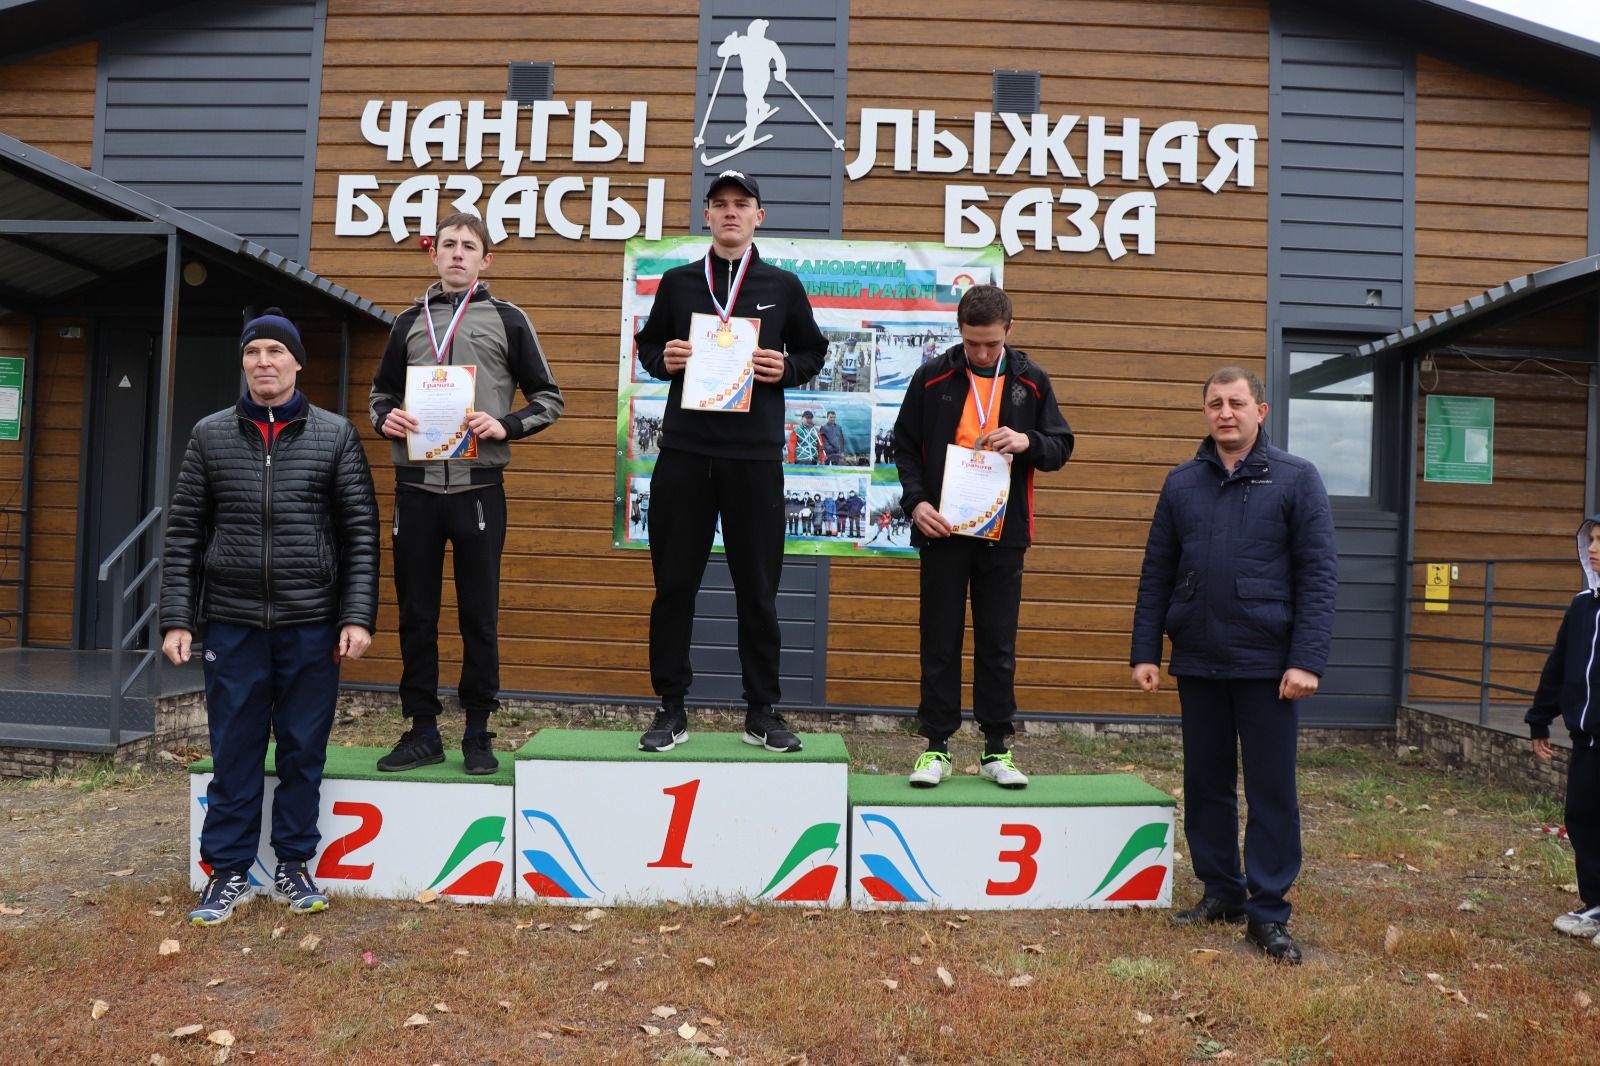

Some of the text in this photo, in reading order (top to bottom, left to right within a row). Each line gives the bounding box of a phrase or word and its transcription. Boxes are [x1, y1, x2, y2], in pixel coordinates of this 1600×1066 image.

[360, 100, 648, 176] ЧАҢГЫ
[845, 107, 1259, 194] ЛЫЖНАЯ
[335, 174, 666, 245] БАЗАСЫ
[944, 184, 1158, 262] БАЗА
[868, 282, 934, 300] РАЙОН
[845, 359, 857, 367] 171
[315, 801, 383, 879] 2
[646, 778, 701, 868] 1
[985, 823, 1042, 895] 3
